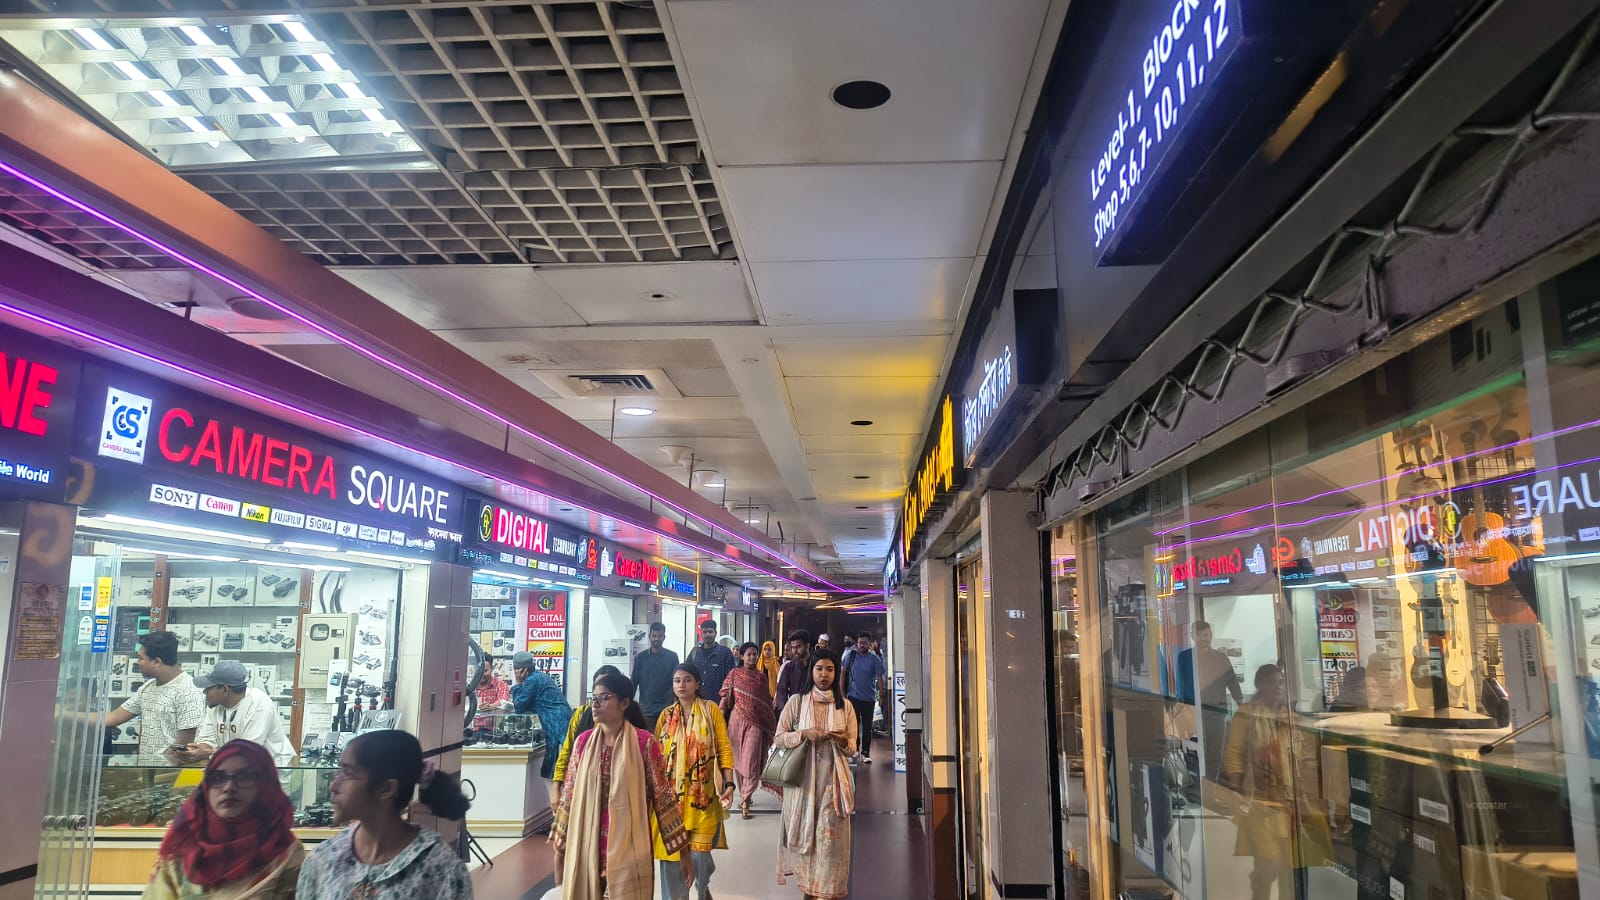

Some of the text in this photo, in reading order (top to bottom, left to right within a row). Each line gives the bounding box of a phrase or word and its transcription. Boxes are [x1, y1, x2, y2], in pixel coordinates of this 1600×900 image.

[1094, 189, 1118, 248] Shop
[102, 442, 141, 457] CAMERA SQUARE
[158, 407, 449, 523] CAMERA SQUARE
[16, 464, 50, 484] World
[154, 487, 193, 505] SONY
[206, 497, 234, 512] Canon
[246, 507, 264, 520] Nikon
[274, 511, 302, 526] FUJIFILM
[309, 517, 332, 531] SIGMA
[495, 507, 550, 555] DIGITAL
[615, 551, 642, 578] Camera
[529, 614, 565, 622] DIGITAL
[530, 629, 562, 638] Canon
